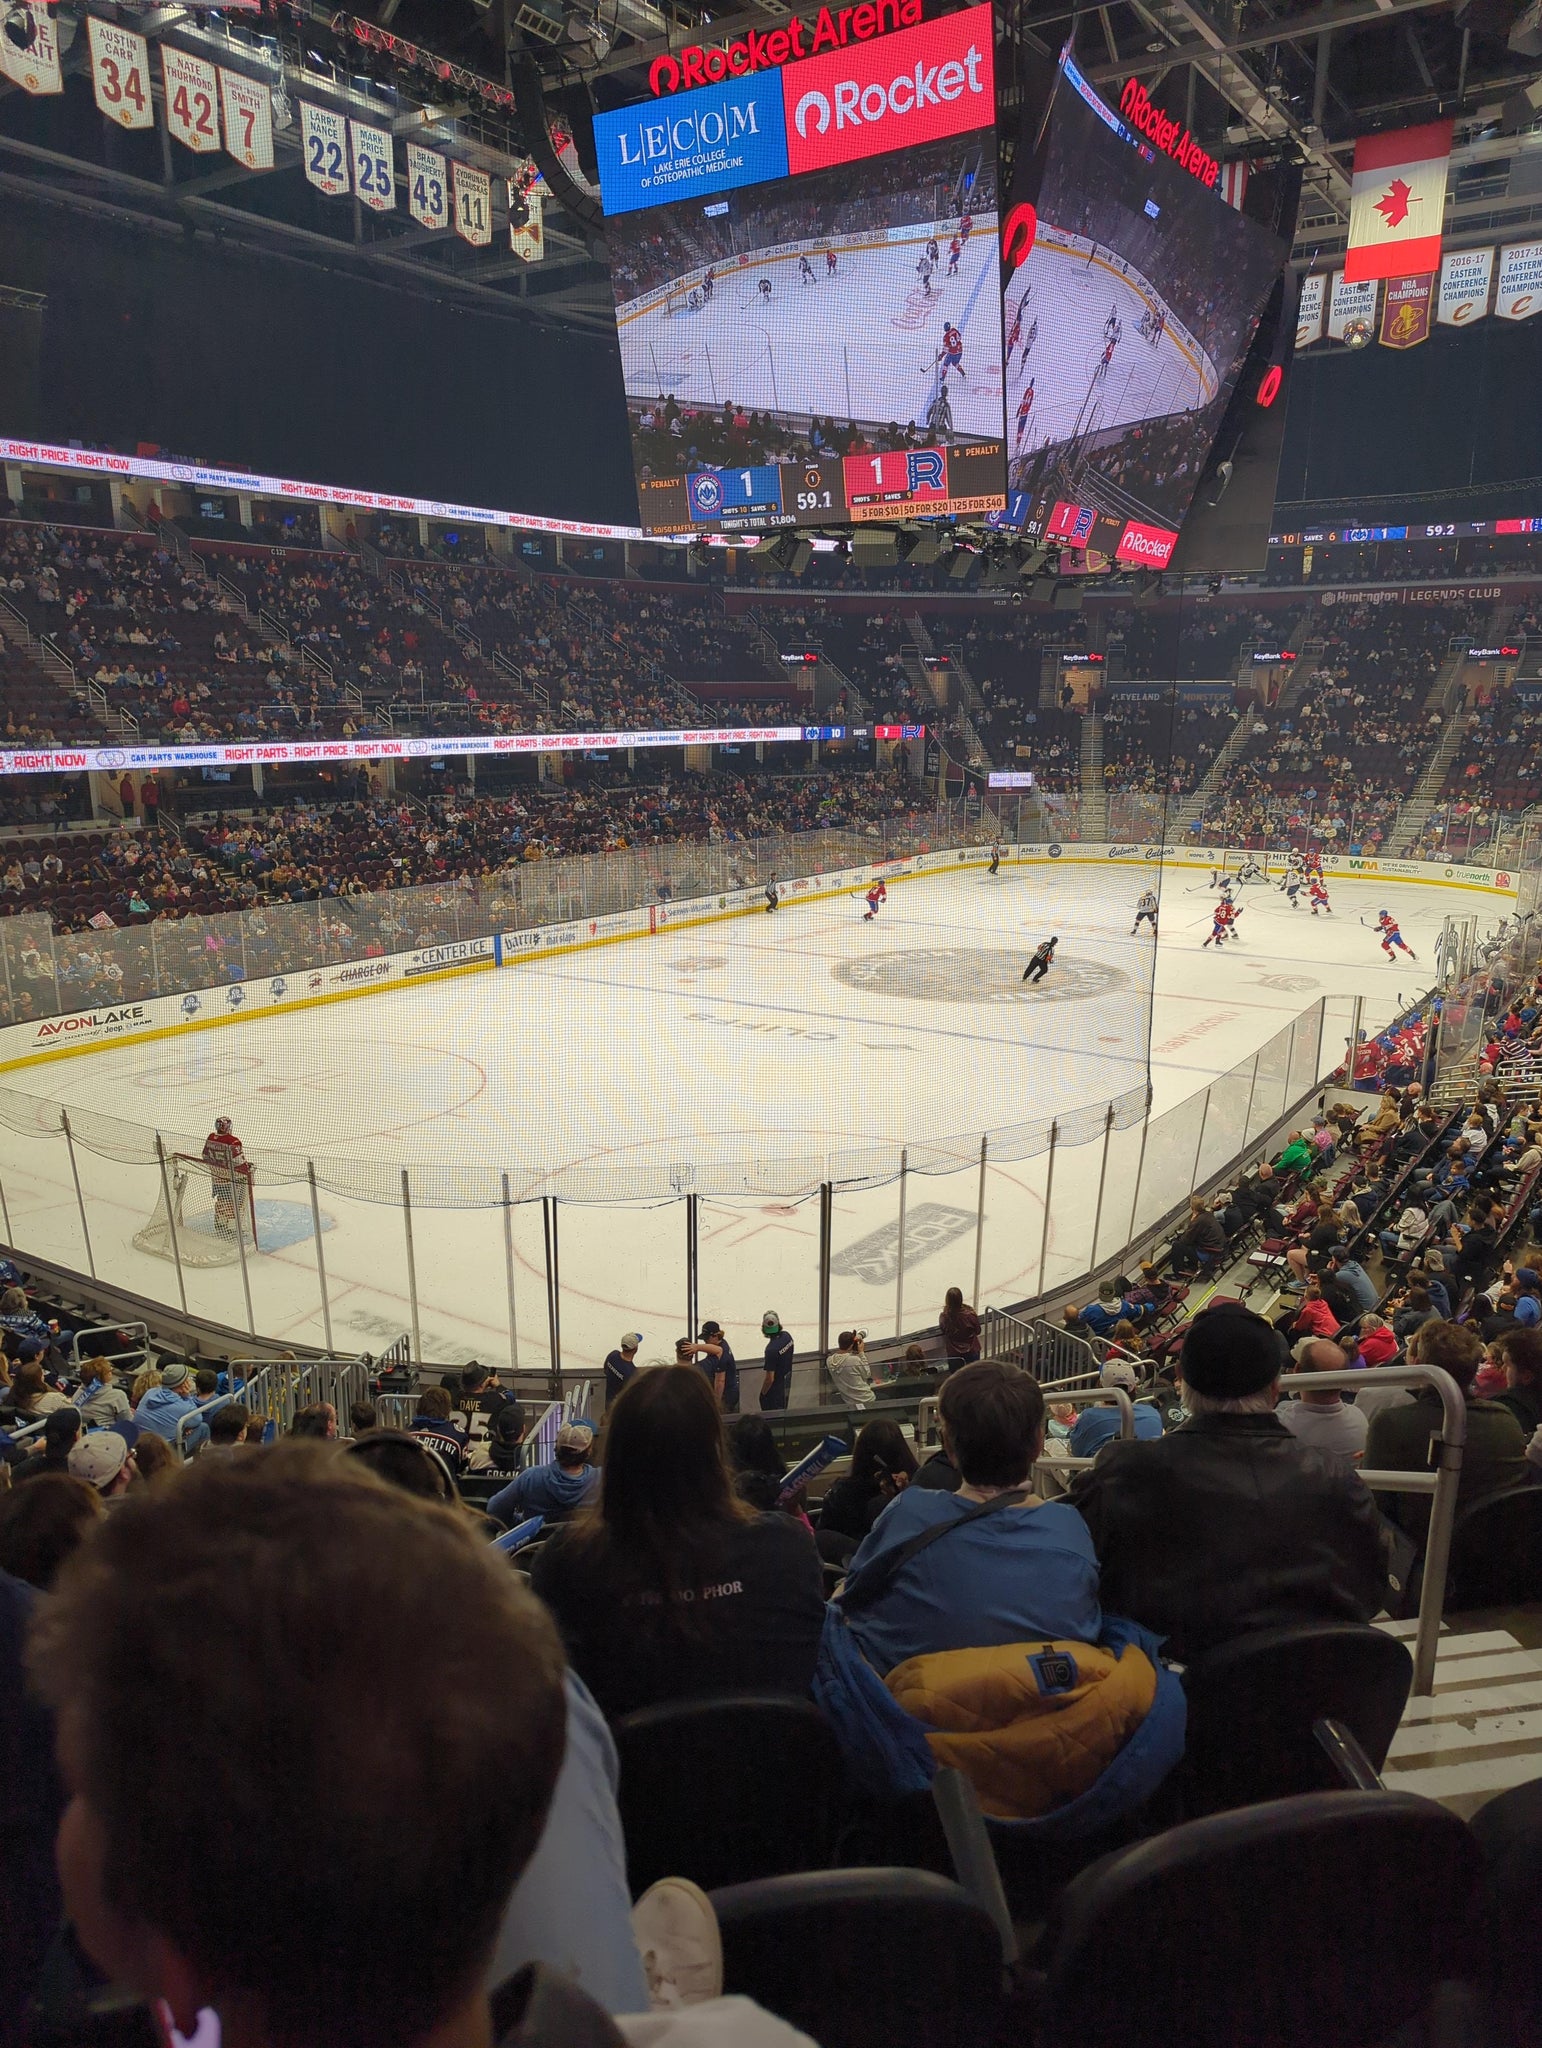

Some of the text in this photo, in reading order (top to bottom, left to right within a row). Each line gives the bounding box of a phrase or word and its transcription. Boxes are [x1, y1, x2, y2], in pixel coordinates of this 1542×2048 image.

[100, 28, 137, 51] AUSTIN
[682, 0, 923, 88] Rocket Arena
[105, 43, 133, 62] CARR
[177, 58, 200, 75] NATE
[101, 57, 145, 111] 34
[166, 65, 213, 92] THURMOND
[834, 43, 984, 131] Rocket
[231, 91, 260, 109] SMITH
[173, 85, 213, 136] 42
[310, 111, 336, 128] LARRY
[239, 108, 255, 149] 7
[311, 122, 338, 140] NANCE
[360, 130, 383, 145] MARK
[1131, 86, 1182, 155] Rocket
[1174, 130, 1219, 187] Arena
[361, 141, 384, 156] PRICE
[309, 135, 344, 181] 22
[416, 151, 436, 166] BRAD
[653, 149, 726, 174] LAKE ERIE COLLEGE
[358, 153, 391, 196] 25
[641, 156, 744, 188] OF OSTEOPATHIC MEDICINE
[413, 174, 443, 215] 43
[462, 193, 485, 231] 11
[1450, 254, 1485, 267] 2016-17
[1508, 259, 1542, 272] EASTERN
[1450, 267, 1483, 280] EASTERN
[1402, 278, 1417, 290] NBA
[1442, 276, 1488, 291] CONFERENCE
[1333, 293, 1375, 307] CONFERENCE
[1388, 287, 1429, 301] CHAMPIONS
[1443, 288, 1485, 301] CHAMPIONS
[1333, 304, 1372, 317] CHAMPIONS
[8, 444, 129, 470] RIGHT PRICE RIGHT NOW
[965, 445, 1000, 457] PENALTY
[870, 456, 882, 485] 1
[209, 473, 226, 482] PARTS
[228, 476, 260, 487] WAREHOUSE
[651, 478, 680, 488] PENALTY
[740, 470, 752, 497] 1
[281, 483, 414, 510] RIGHT PARTS RIGHT PRICE RIGHT NOW
[797, 491, 832, 510] 59.1
[853, 493, 901, 503] SHOTS SAVES
[862, 498, 1002, 517] 5 FOR $10 50 FOR $20 125 FOR $40
[1012, 495, 1022, 517] 1
[509, 515, 611, 535] RIGHT PARTS RIGHT PRICE RIGHT NOW
[720, 515, 797, 529] TONIGHT'S TOTAL $1,804
[1061, 507, 1070, 528] 1
[653, 523, 696, 534] 50/50 RAFFLE
[1027, 520, 1042, 535] 59.1
[1426, 524, 1455, 537] 59.2
[1282, 534, 1294, 544] 10
[1303, 533, 1323, 542] SAVES
[1329, 532, 1336, 541] 6
[1132, 533, 1171, 559] Rocket
[1337, 588, 1501, 605] Huntington LEGENDS CLUB
[1063, 654, 1089, 662] KeyBank
[1253, 652, 1281, 660] KeyBank
[1469, 648, 1501, 656] KeyBank
[1183, 693, 1231, 701] MONSTERS
[683, 733, 698, 742] RIGHT
[699, 732, 715, 741] PARTS
[718, 732, 731, 740] RIGHT
[732, 731, 746, 739] PRICE
[749, 731, 763, 739] RIGHT
[832, 728, 841, 737] 10
[442, 742, 458, 750] PARTS
[460, 741, 489, 749] WAREHOUSE
[494, 735, 617, 749] RIGHT PARTS RIGHT PRICE RIGHT NOW
[131, 751, 217, 762] CAR PARTS WAREHOUSE
[225, 743, 402, 760] RIGHT PARTS RIGHT PRICE RIGHT NOW
[14, 753, 86, 768] RIGHT NOW
[1108, 845, 1139, 858] Culver's
[1146, 847, 1175, 859] Culver's
[1349, 860, 1378, 870] WM
[1382, 867, 1422, 875] SUSTAINABILITY
[1456, 870, 1490, 882] truenorth
[1142, 898, 1150, 906] 37
[559, 932, 576, 945] slaps
[421, 940, 485, 964] CENTER ICE
[340, 965, 375, 982] CHARGE
[376, 962, 389, 974] ON
[104, 1024, 123, 1034] Jeep
[460, 1400, 482, 1411] DAVE
